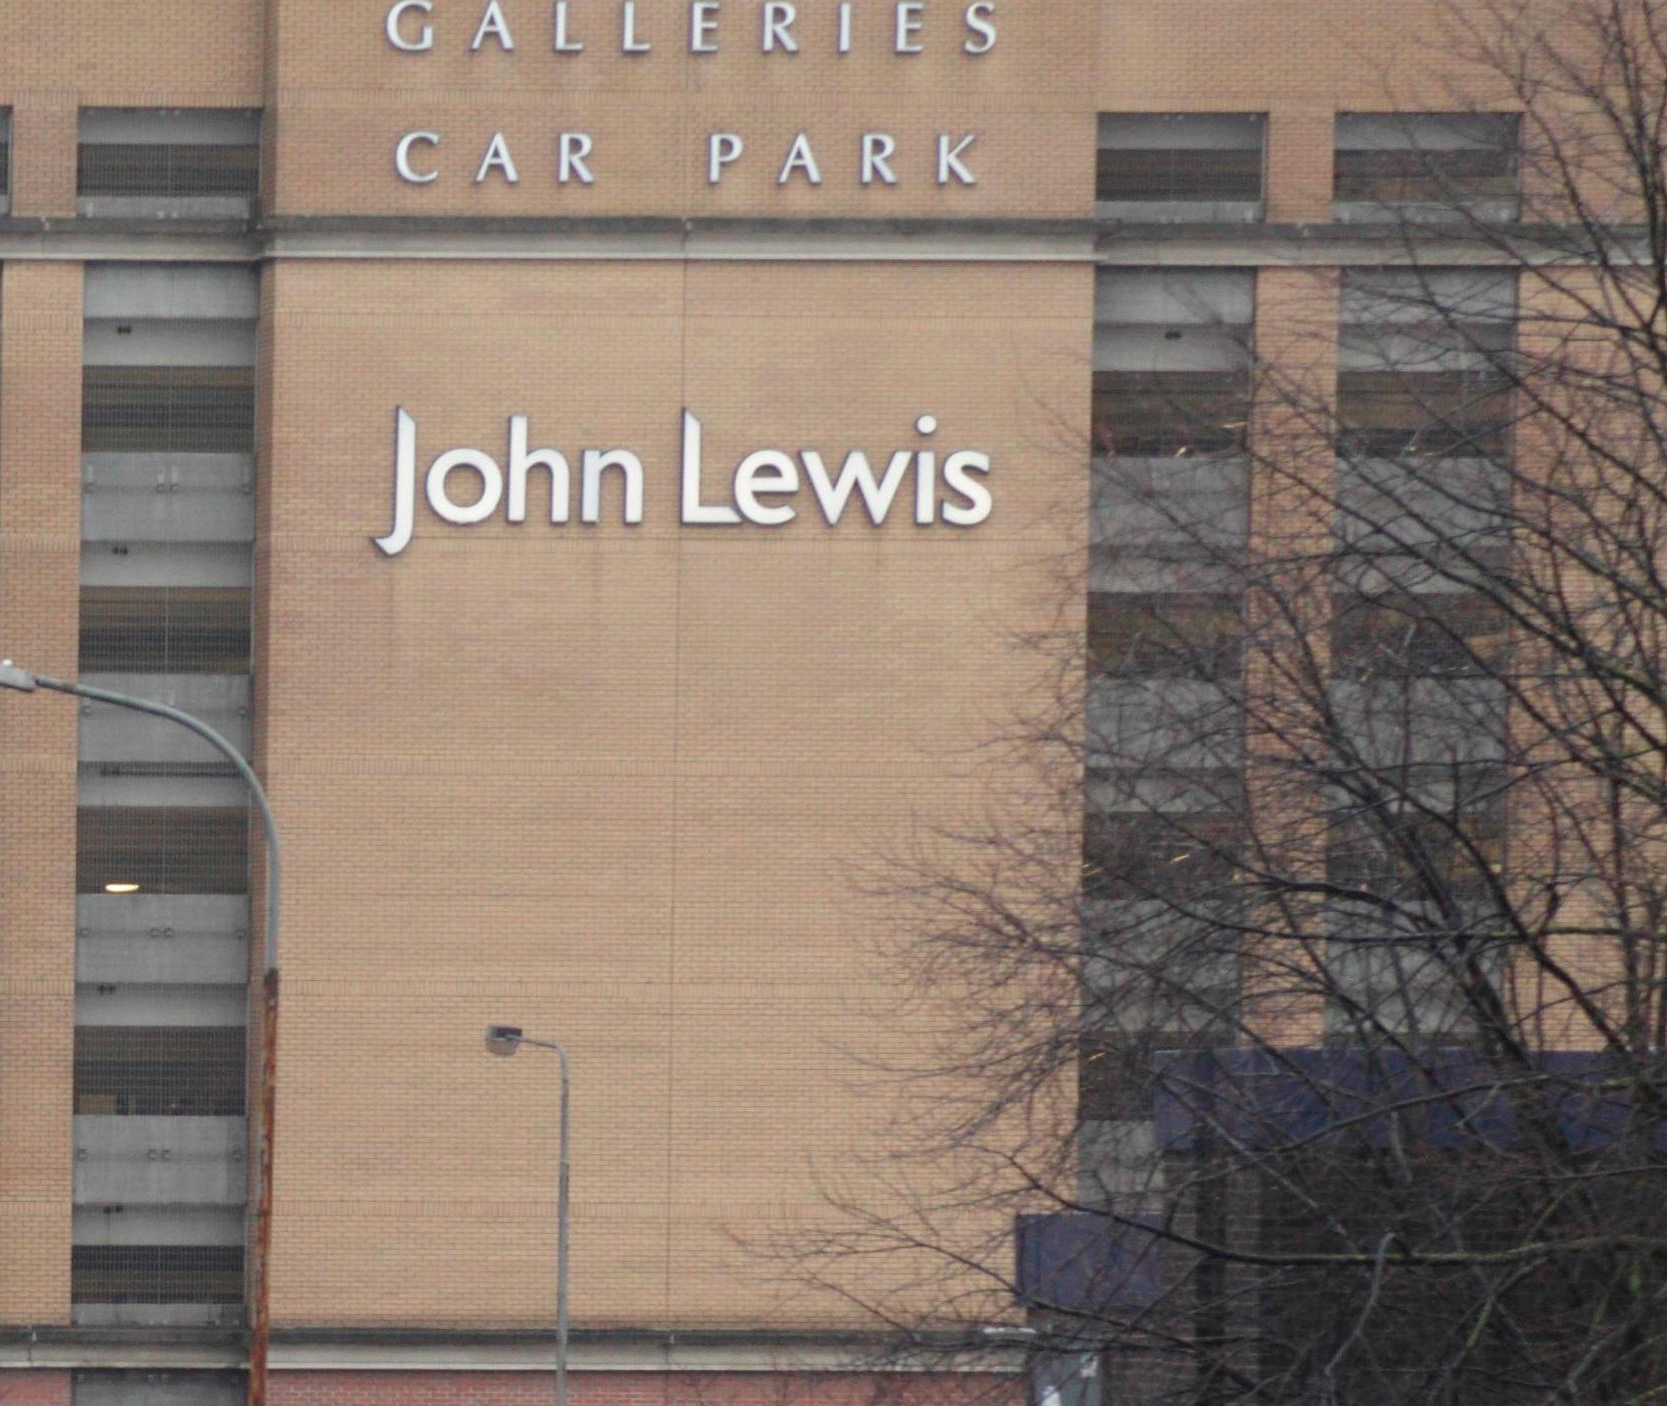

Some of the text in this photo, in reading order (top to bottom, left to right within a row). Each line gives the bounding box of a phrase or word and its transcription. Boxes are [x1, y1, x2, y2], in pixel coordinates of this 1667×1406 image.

[385, 0, 999, 54] GALLERIES
[394, 130, 979, 185] CAR PARK
[372, 405, 995, 556] John Lewis
